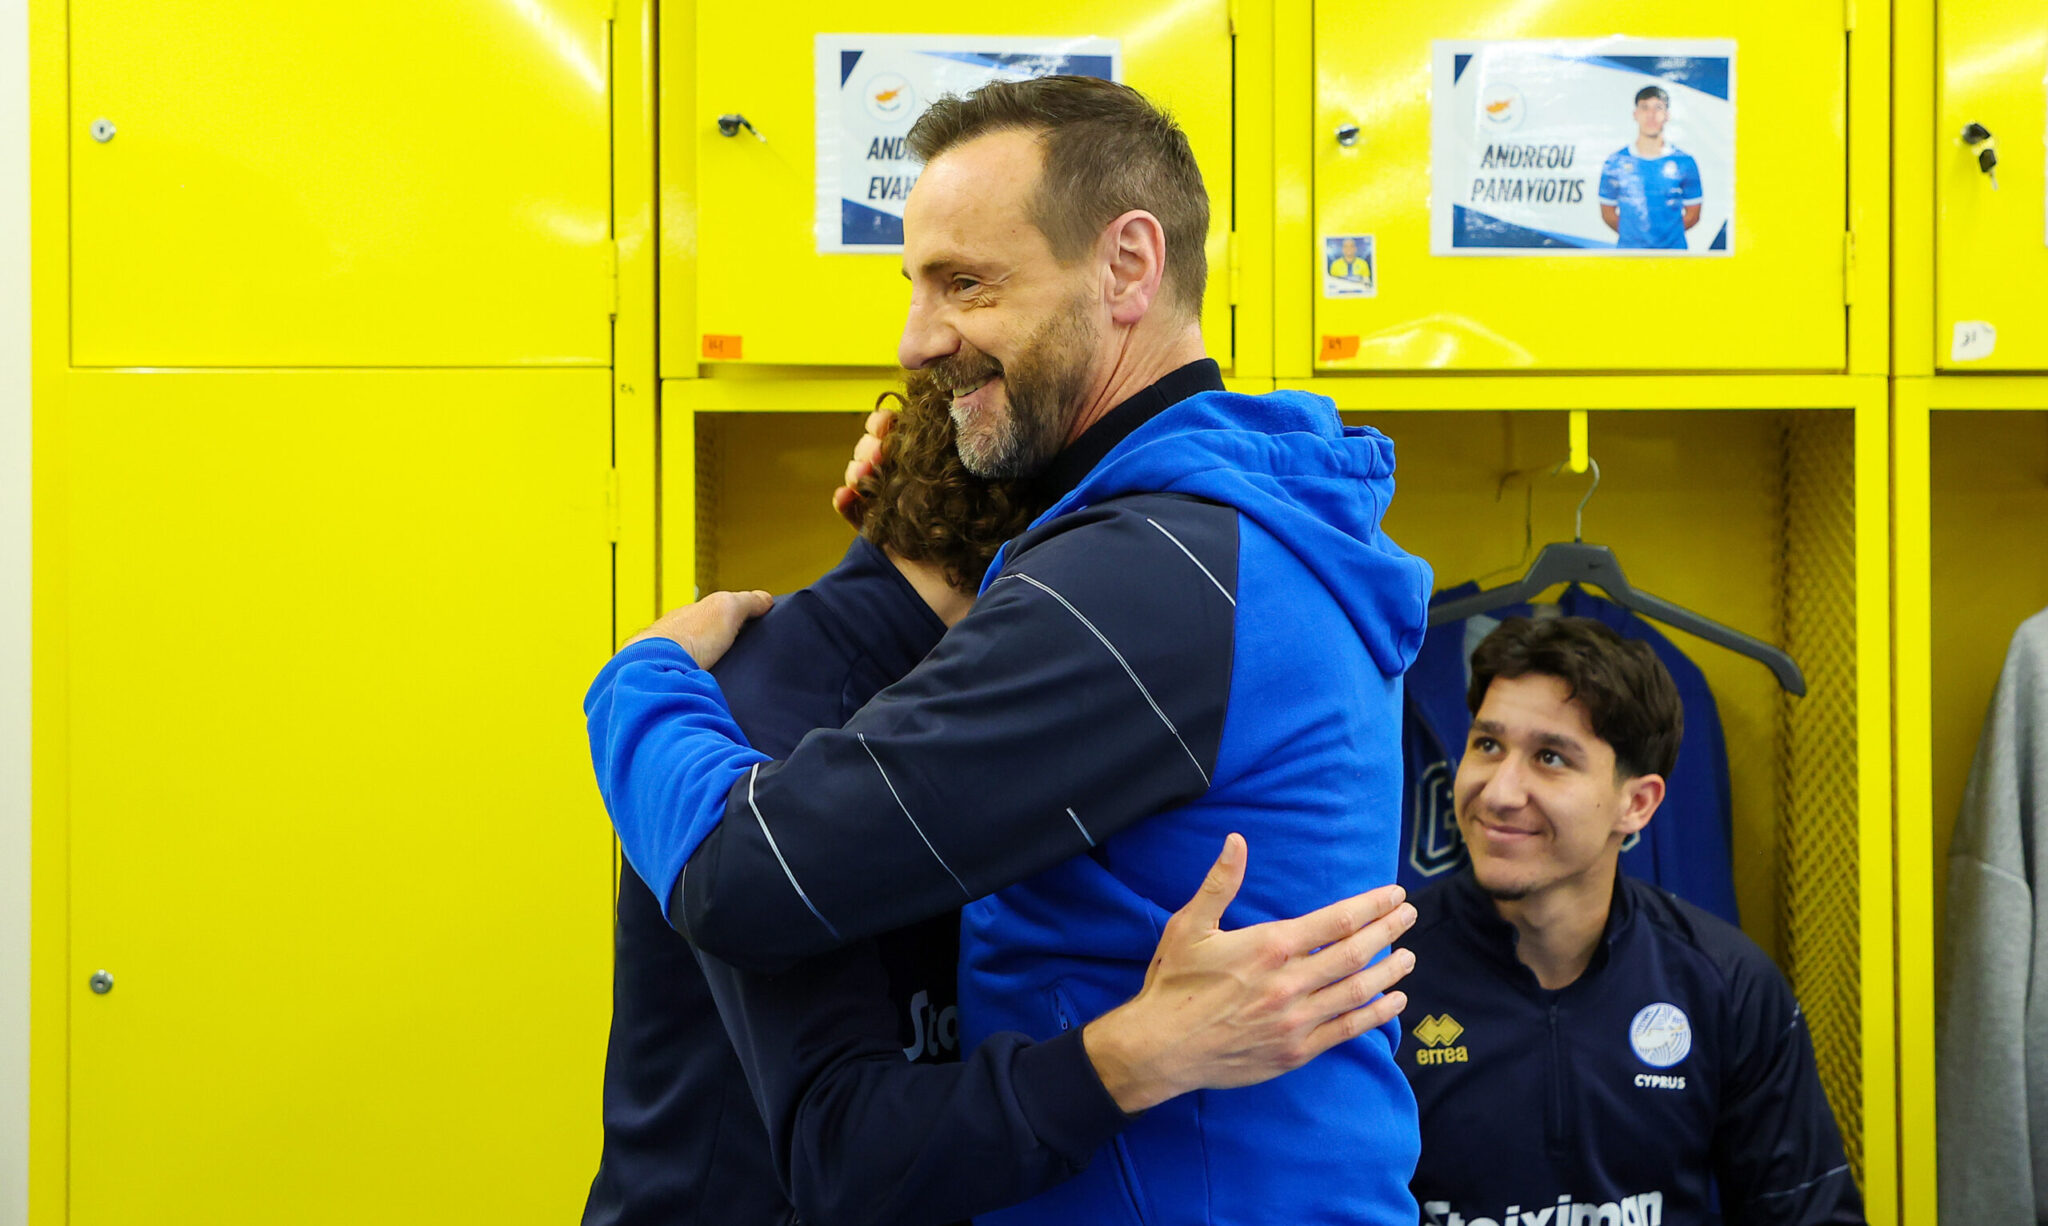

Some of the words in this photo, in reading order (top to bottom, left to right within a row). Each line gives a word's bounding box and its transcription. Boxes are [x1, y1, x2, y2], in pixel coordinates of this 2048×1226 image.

[867, 136, 912, 160] AND
[1480, 144, 1575, 169] ANDREOU
[1471, 177, 1585, 203] PANAYIOTIS
[1416, 1045, 1469, 1065] errea
[1634, 1073, 1686, 1090] CYPRUS
